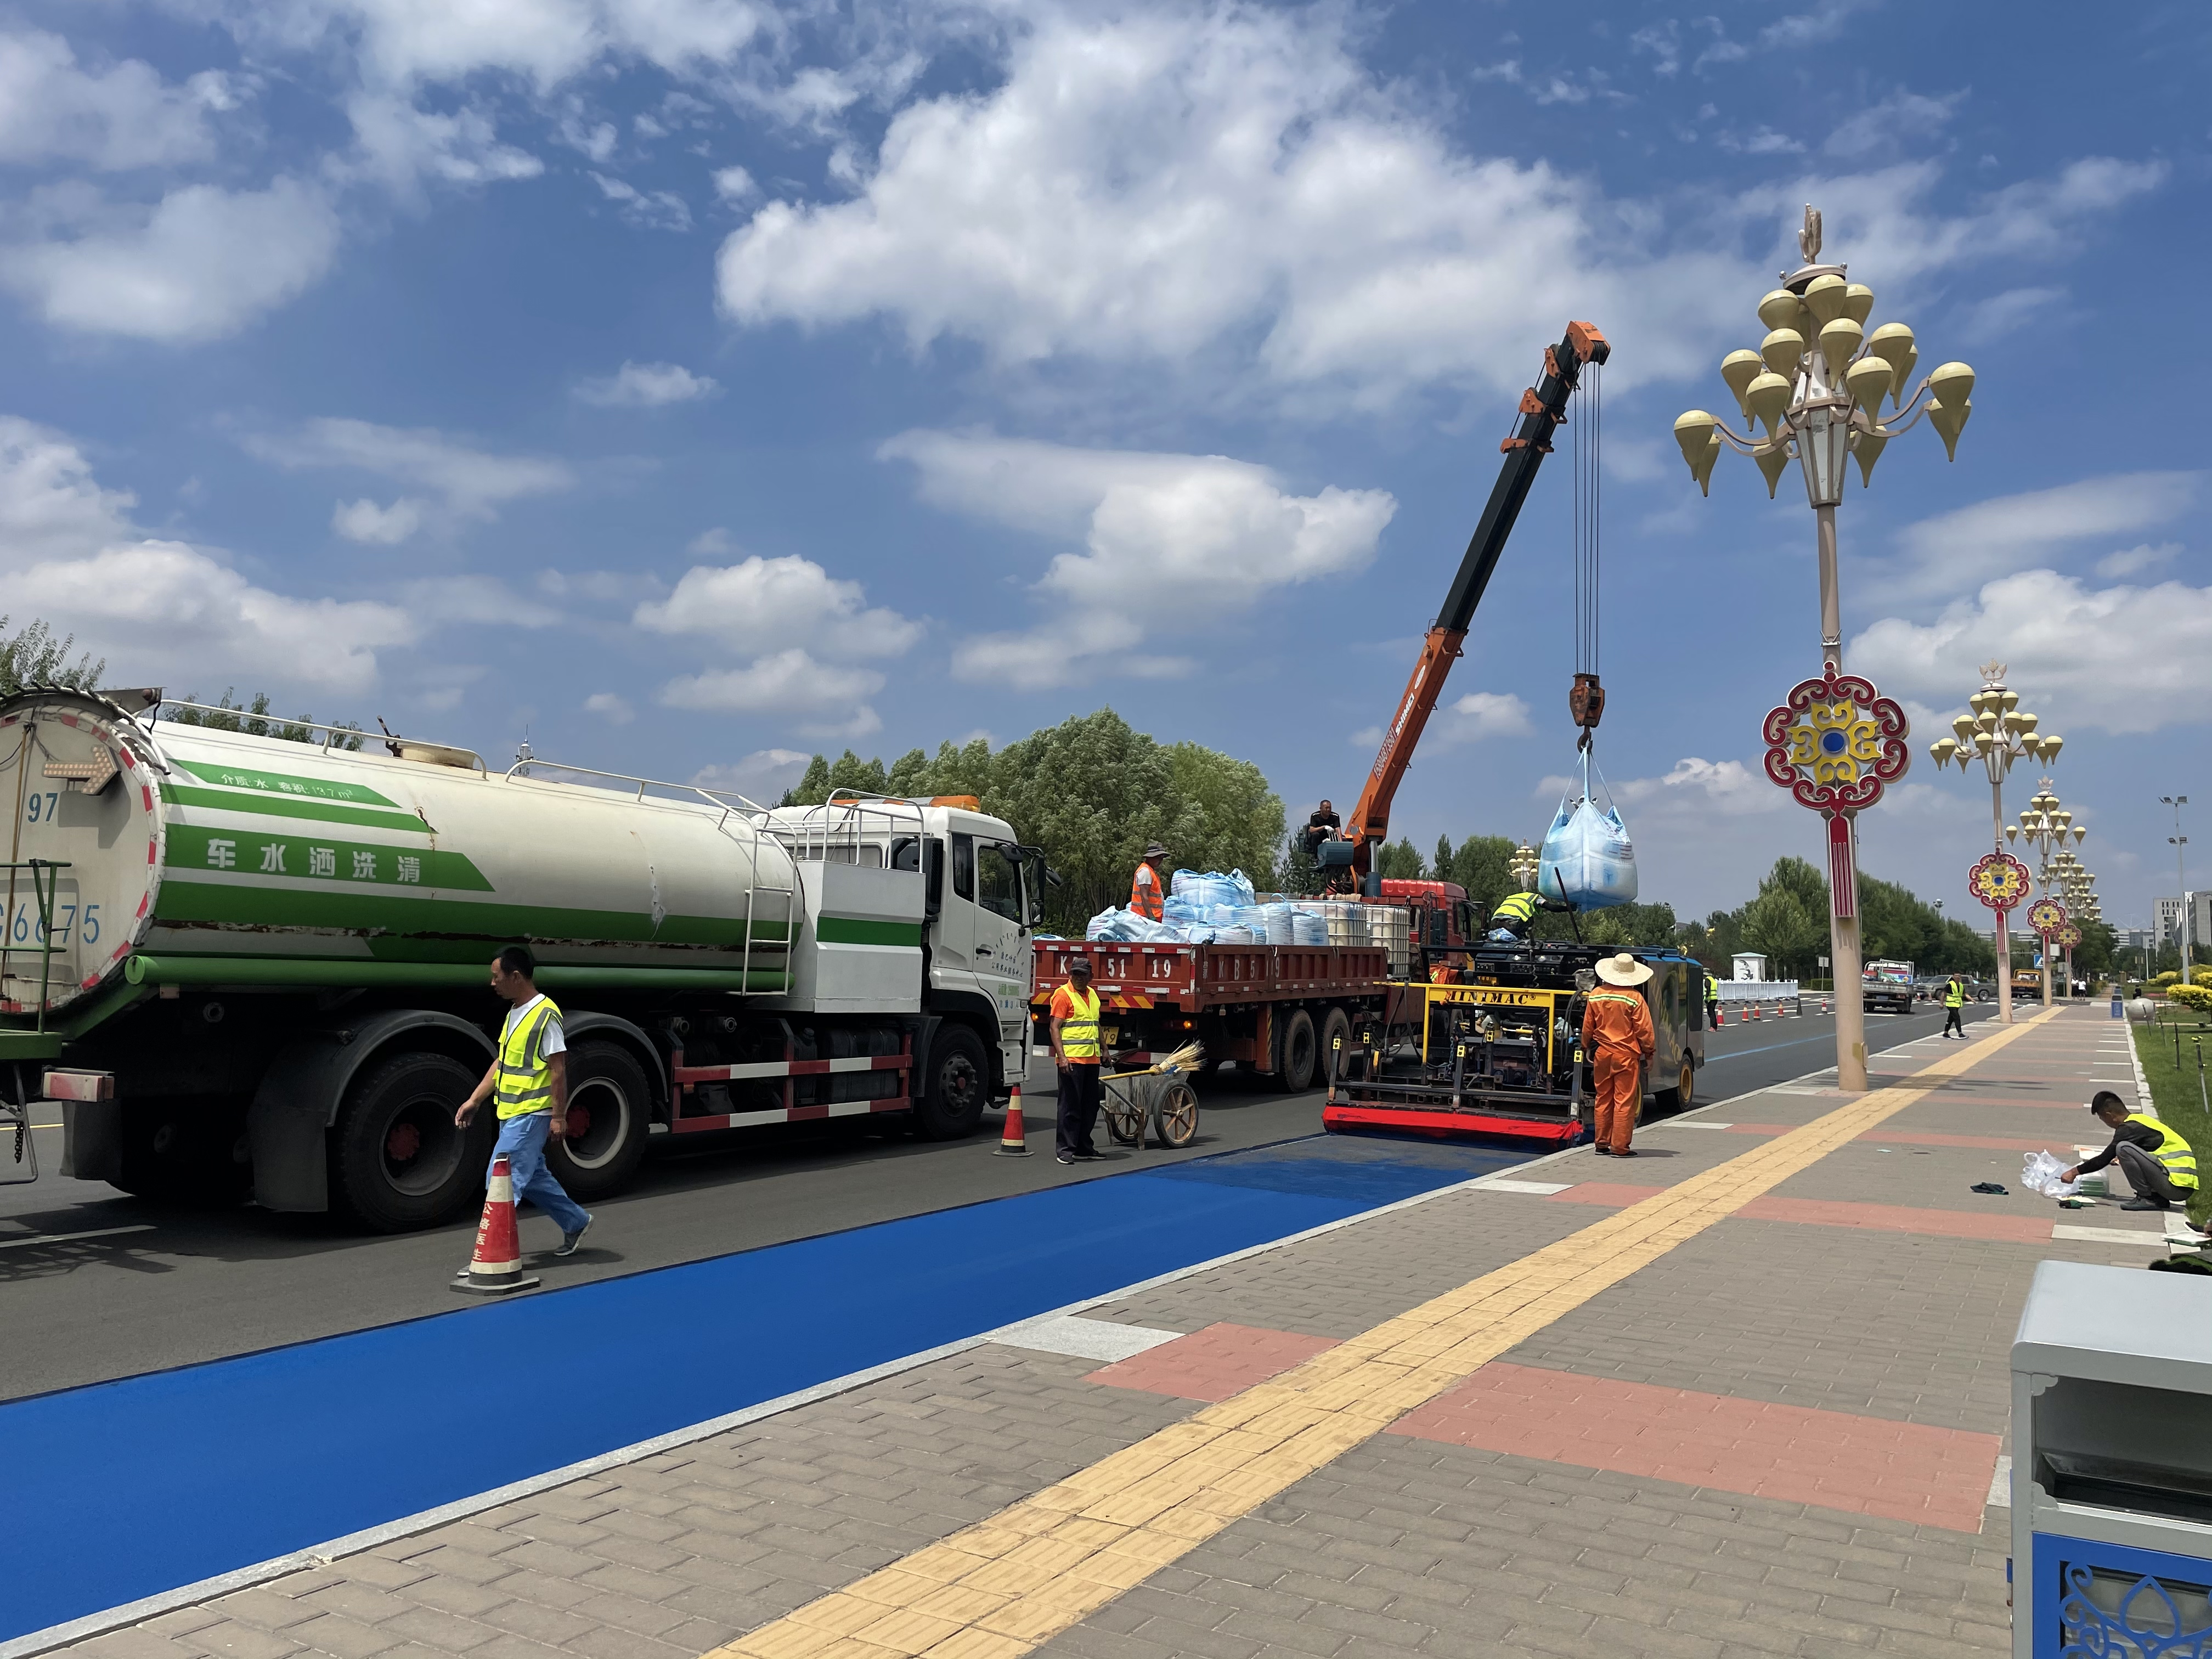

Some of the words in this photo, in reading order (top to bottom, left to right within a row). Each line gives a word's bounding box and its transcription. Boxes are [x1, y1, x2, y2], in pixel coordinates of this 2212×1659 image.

[28, 793, 58, 822] 97
[472, 1202, 494, 1261] 公路医生
